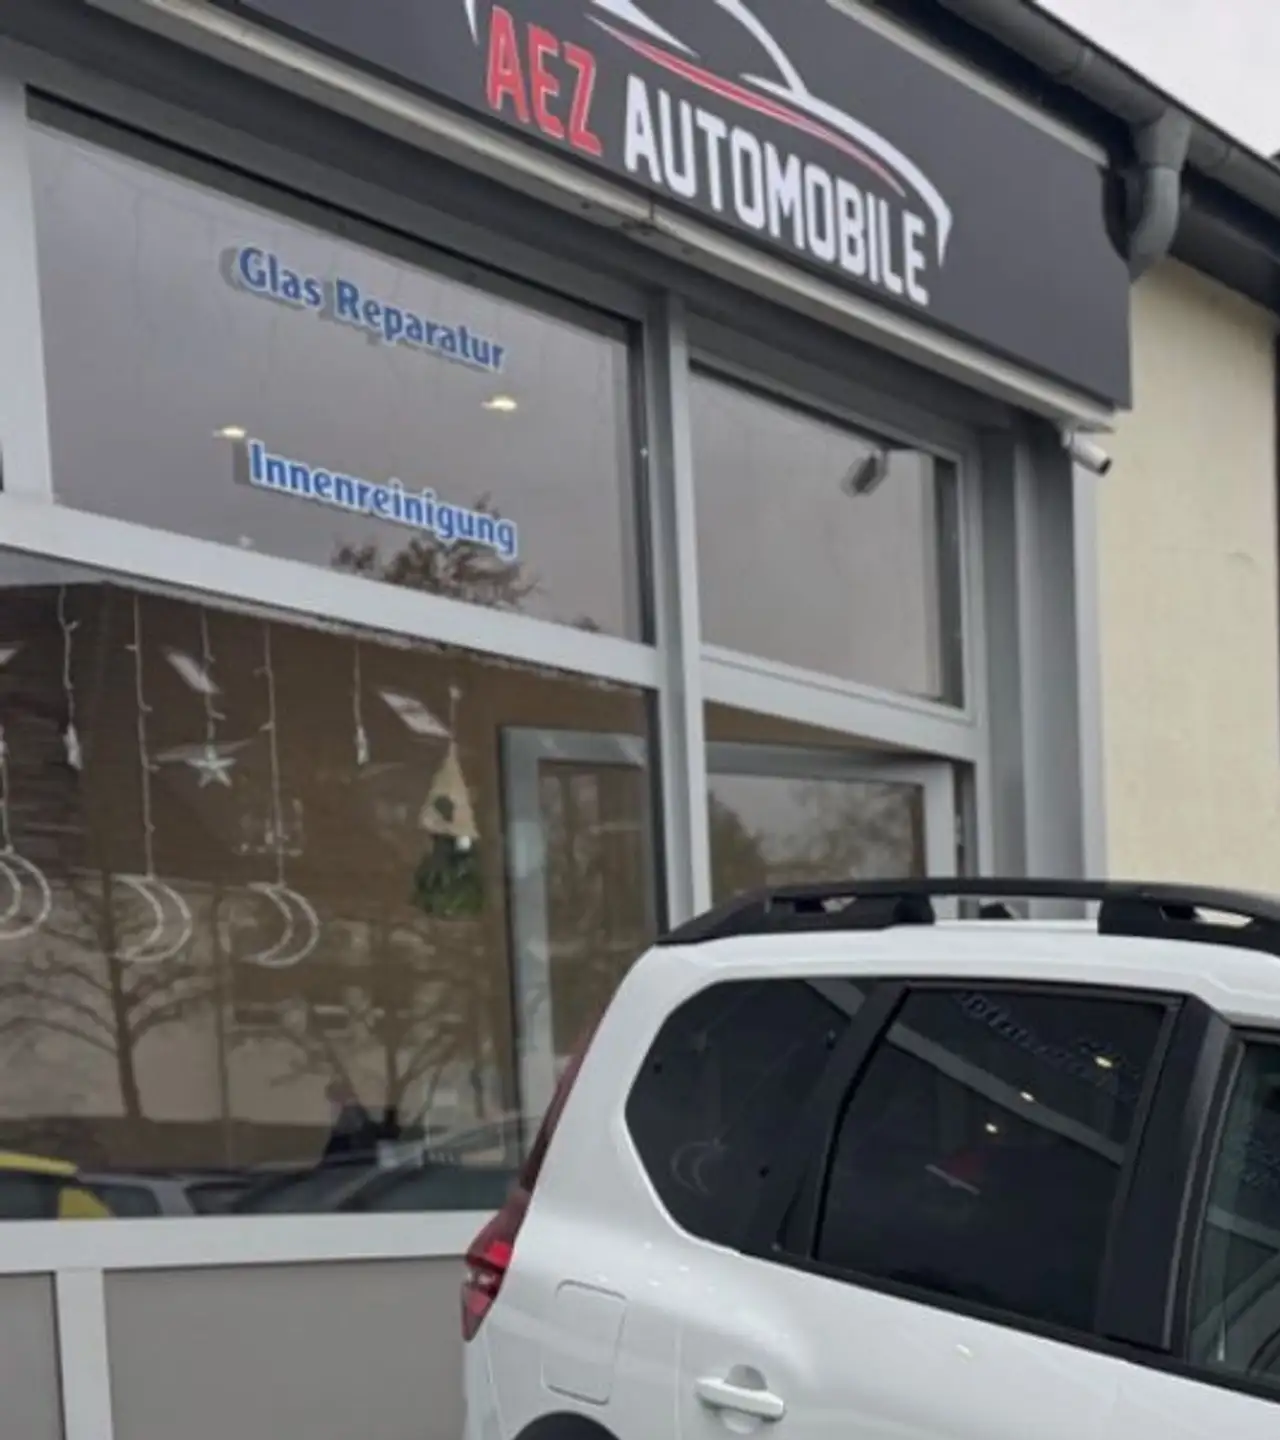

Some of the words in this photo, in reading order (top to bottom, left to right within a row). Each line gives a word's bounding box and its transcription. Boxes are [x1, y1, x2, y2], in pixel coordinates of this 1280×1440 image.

[486, 5, 602, 157] AEZ
[624, 73, 929, 306] AUTOMOBILE
[238, 245, 322, 307] Glas
[334, 275, 505, 369] Reparatur
[250, 442, 516, 556] Innenreinigung
